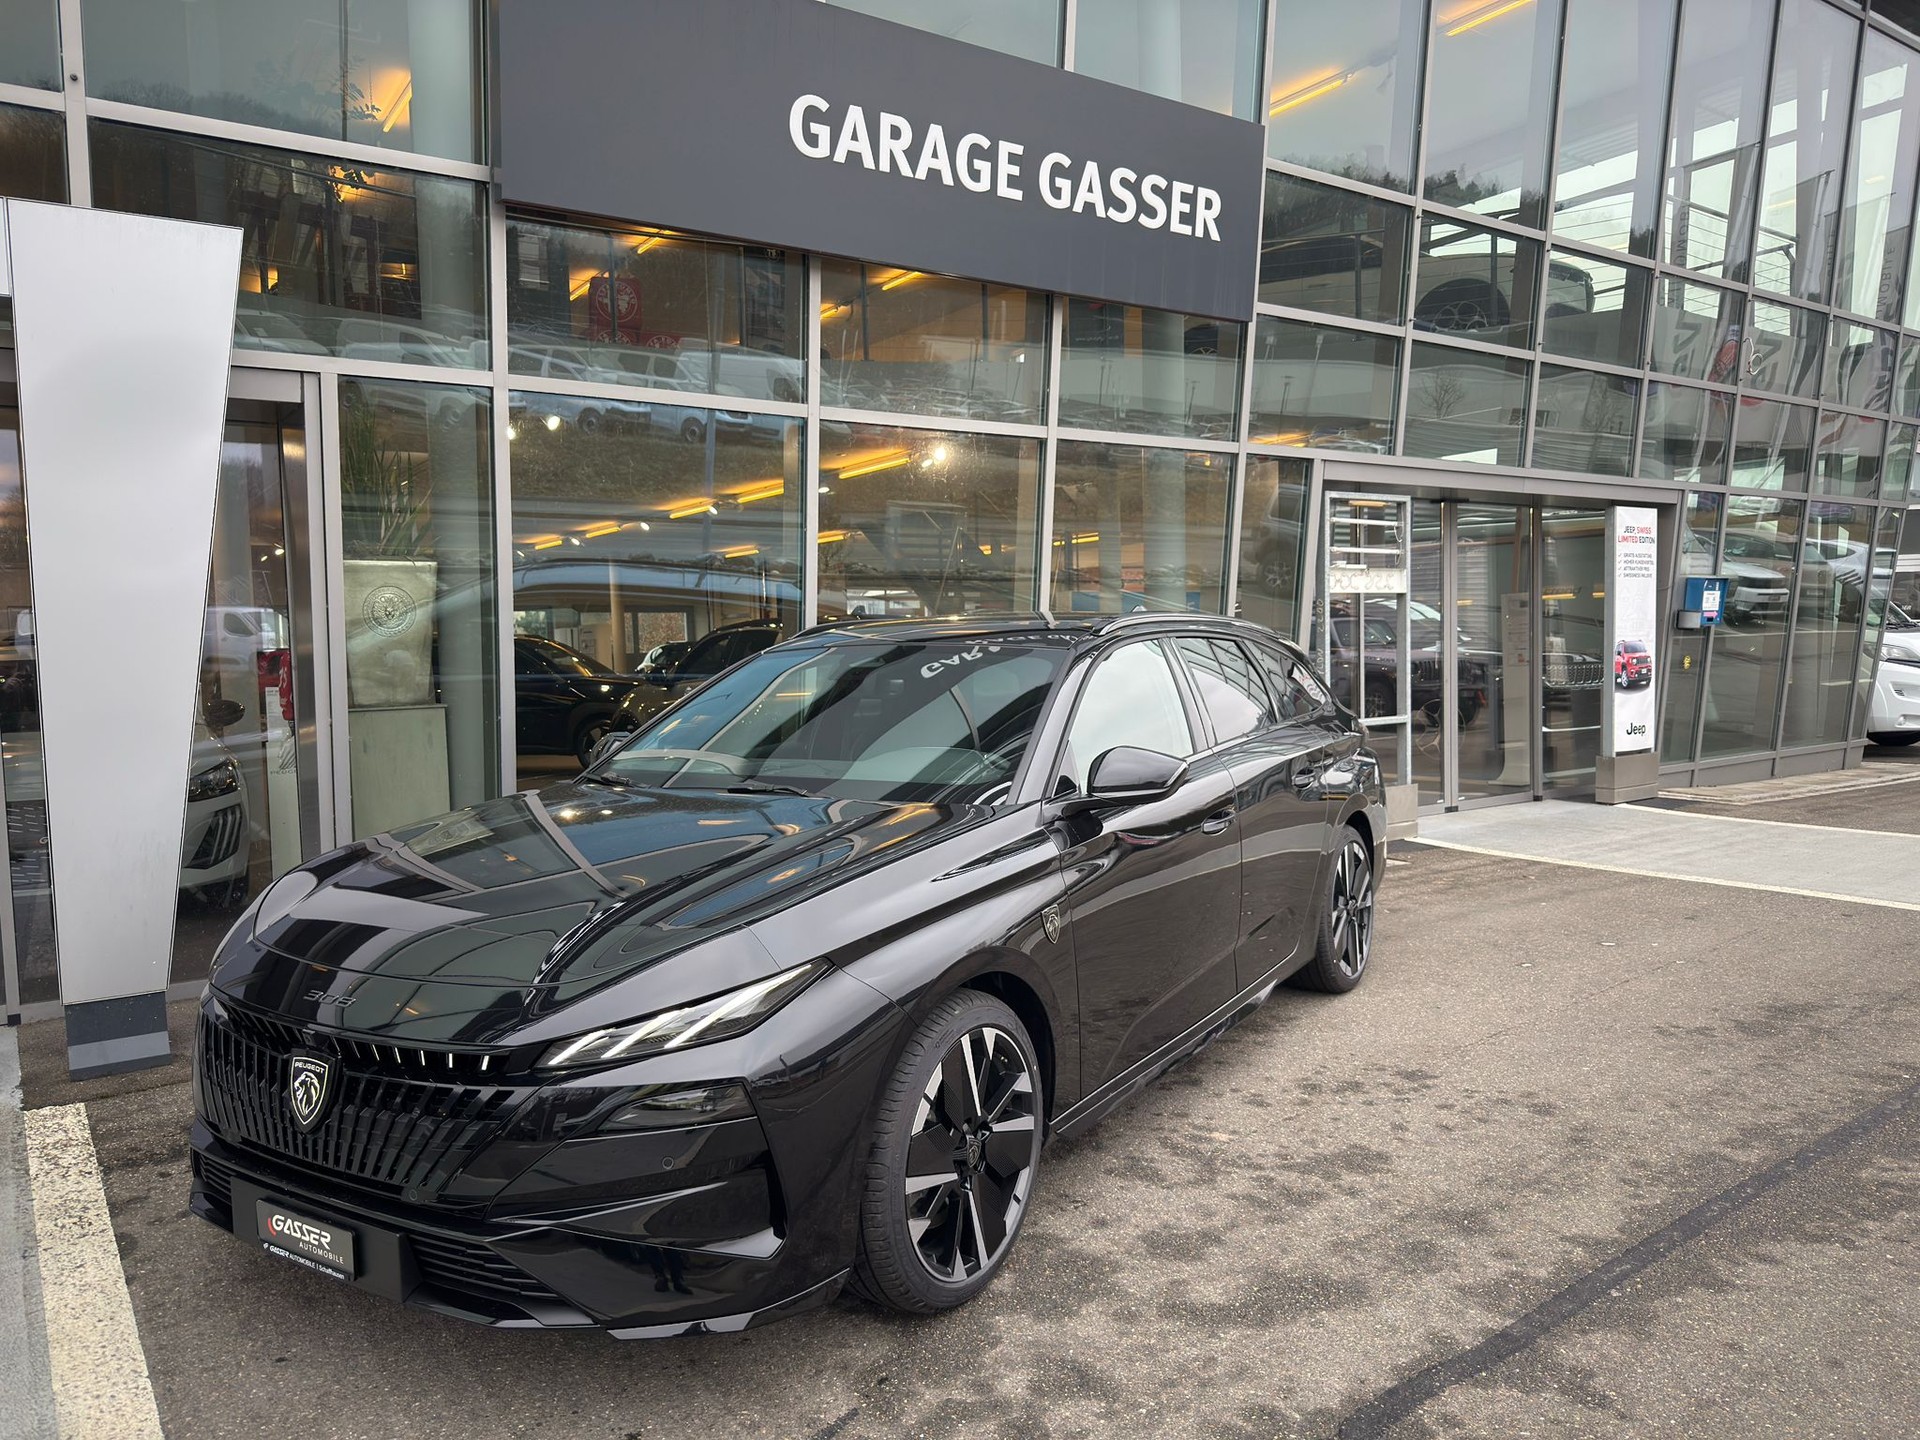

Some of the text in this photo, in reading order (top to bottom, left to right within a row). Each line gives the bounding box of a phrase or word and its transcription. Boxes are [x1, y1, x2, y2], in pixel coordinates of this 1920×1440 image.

[789, 94, 1223, 242] GARAGE GASSER
[1636, 526, 1652, 534] SWISS
[1617, 535, 1656, 544] LIMITED EDITION
[1626, 722, 1647, 737] Jeep
[303, 989, 357, 1007] 308
[294, 1061, 325, 1075] PEUGEOT
[271, 1214, 331, 1250] GASSER
[269, 1245, 290, 1259] GASSER
[289, 1252, 316, 1269] AUTOMOBILE
[299, 1241, 345, 1265] AUTOMOBILE
